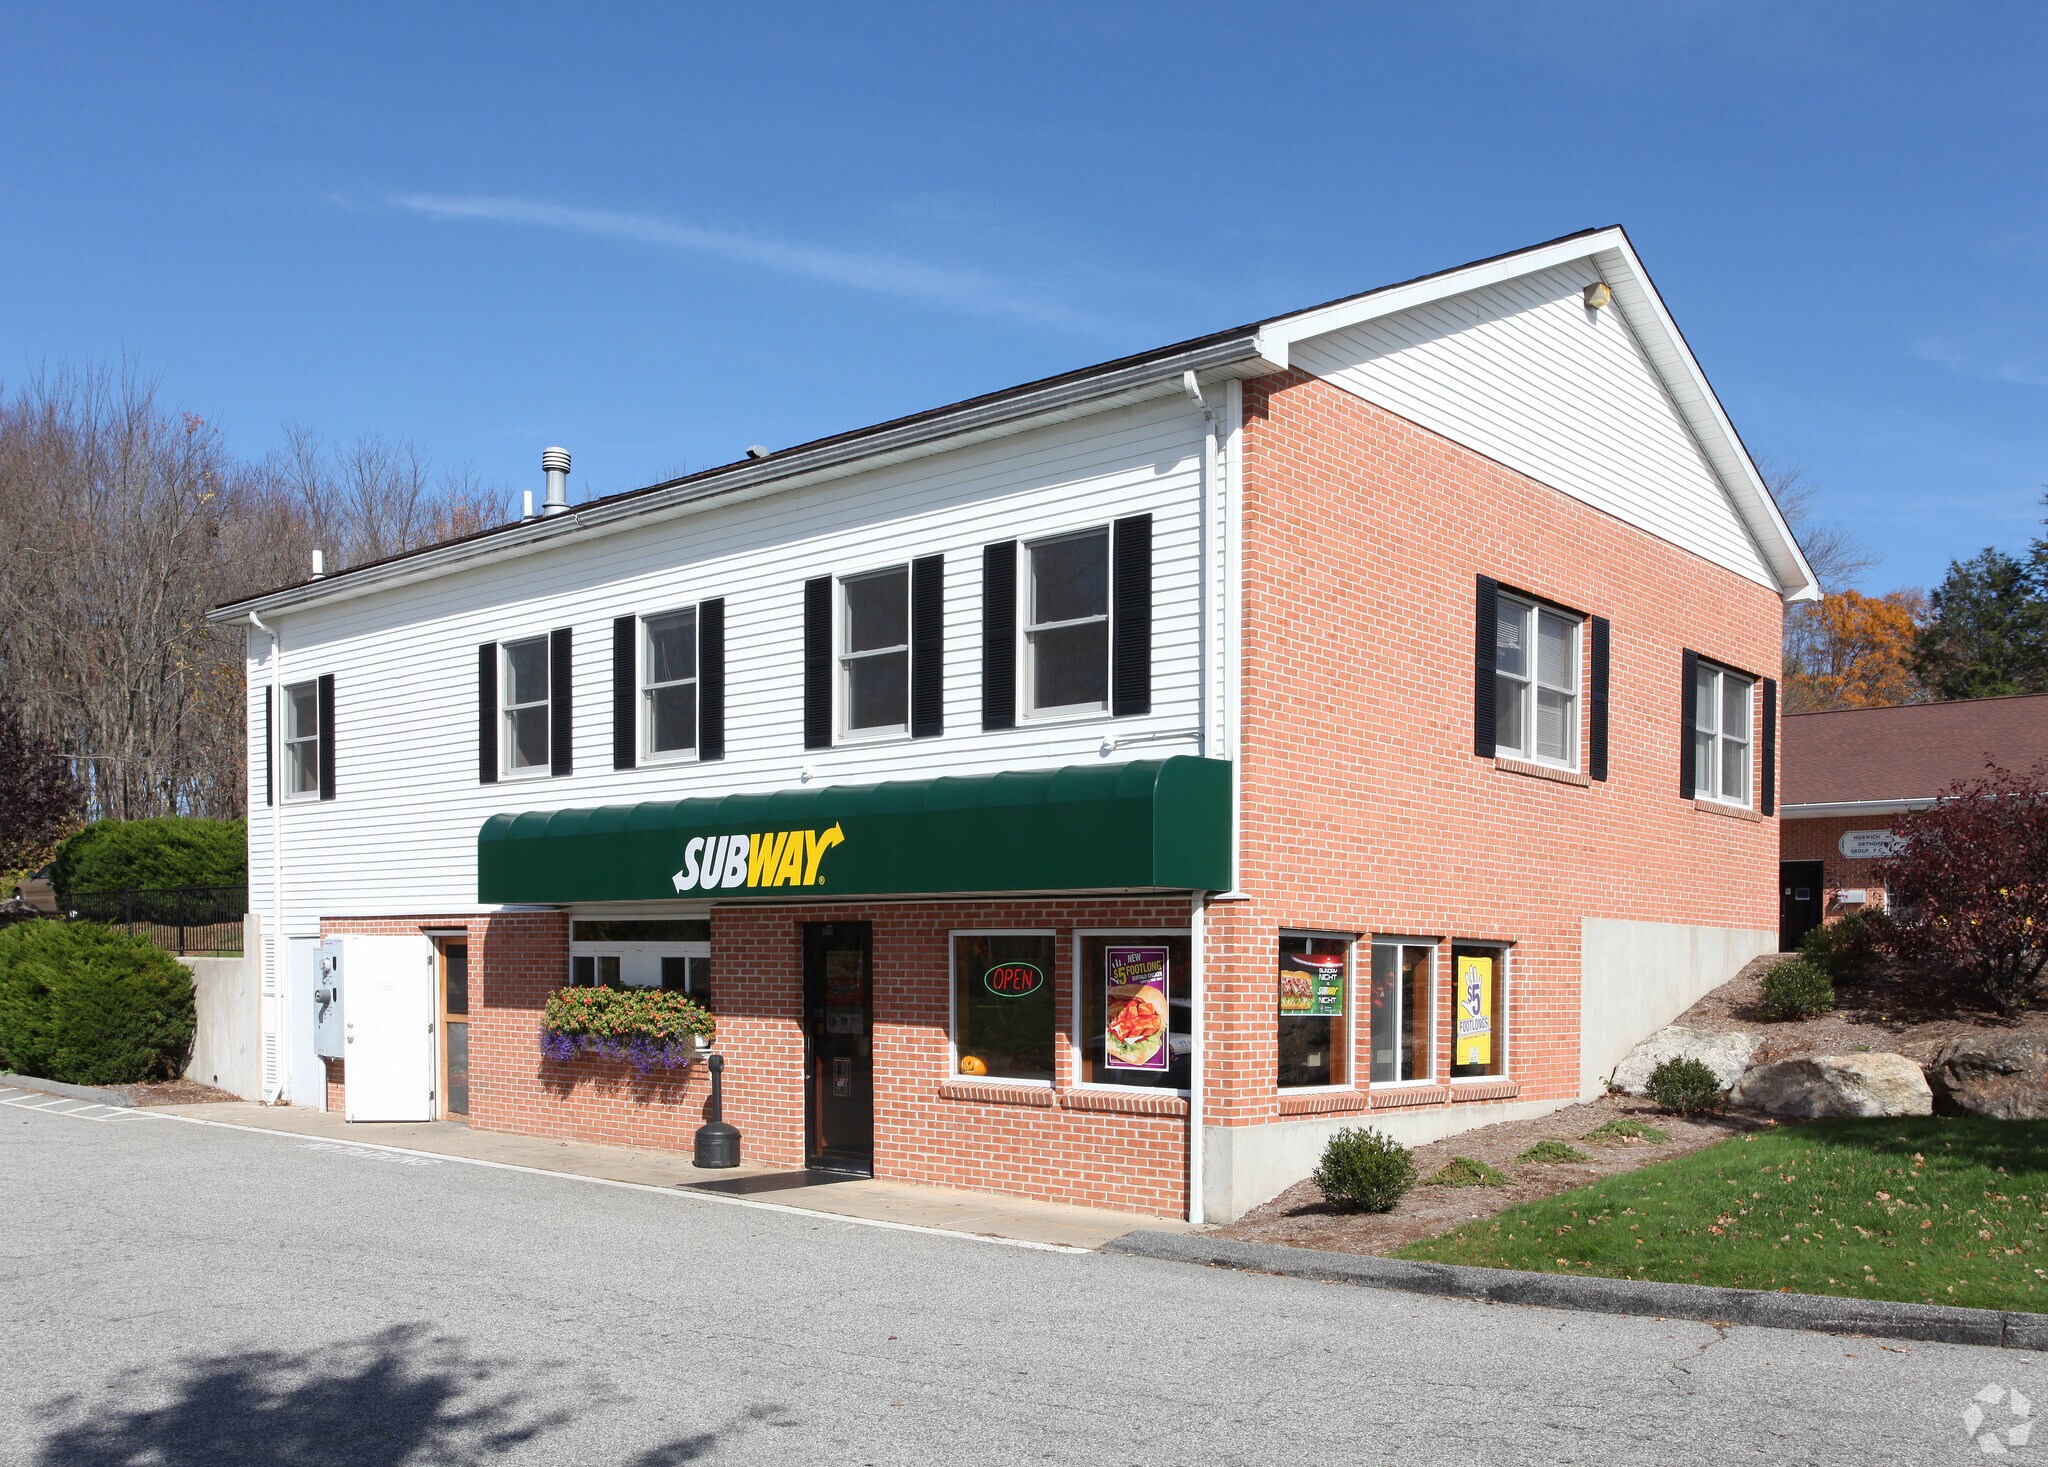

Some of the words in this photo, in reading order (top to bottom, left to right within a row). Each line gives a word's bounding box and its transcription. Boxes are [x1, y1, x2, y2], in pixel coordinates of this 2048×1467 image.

[672, 821, 845, 894] SUBWAY
[1127, 953, 1141, 963] NEW
[993, 968, 1034, 990] OPEN
[1113, 966, 1127, 986] $5
[1126, 960, 1162, 975] FOOTLONG
[1317, 986, 1338, 995] SUBWAY
[1467, 983, 1480, 1016] $5
[1459, 1016, 1489, 1033] FOOTLONGS
